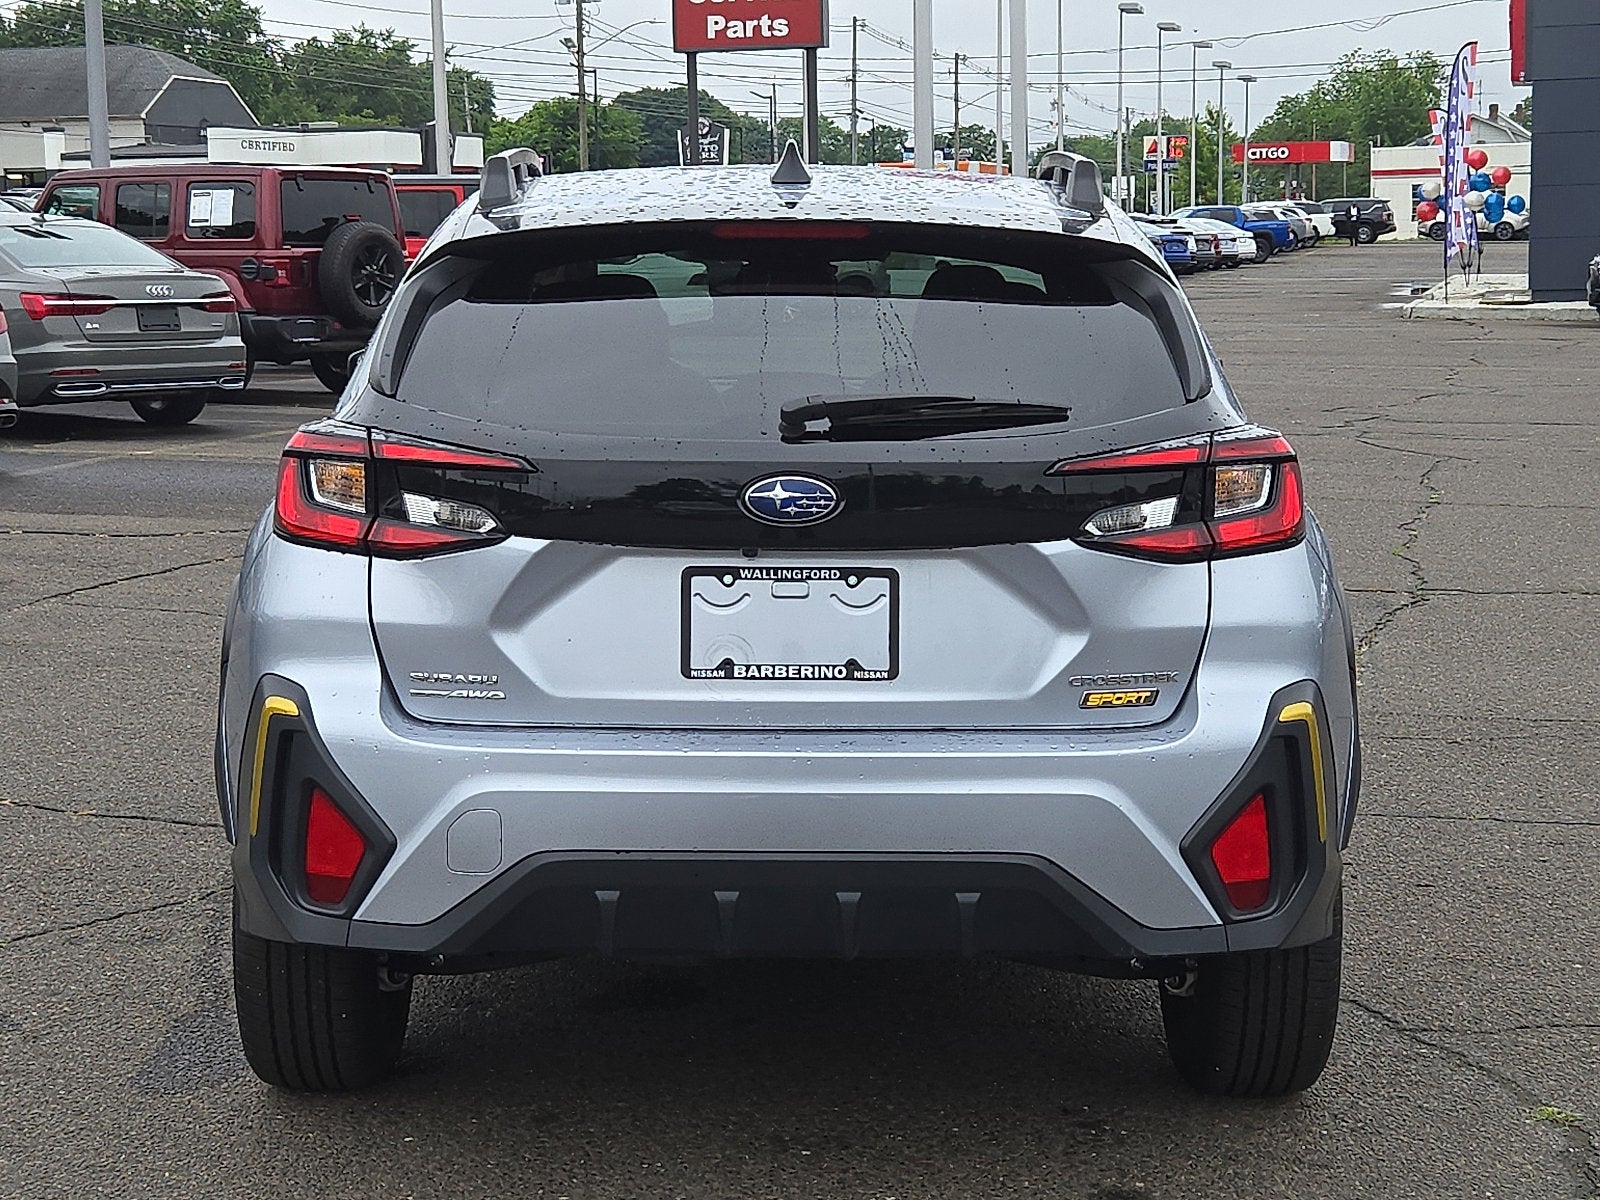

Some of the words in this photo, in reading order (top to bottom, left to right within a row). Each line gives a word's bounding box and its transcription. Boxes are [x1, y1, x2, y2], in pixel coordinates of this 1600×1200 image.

[706, 14, 790, 39] Parts
[240, 139, 295, 152] CERTIFIED
[1247, 146, 1290, 160] CITGO
[739, 569, 841, 580] WALLINGFORD
[409, 671, 499, 684] SUBARU
[690, 669, 725, 678] NISSAN
[733, 664, 848, 679] BARBERINO
[853, 670, 889, 679] NISSAN
[1069, 671, 1179, 686] CROSSTREK
[446, 688, 506, 699] AWD
[1086, 692, 1151, 706] SPORT
